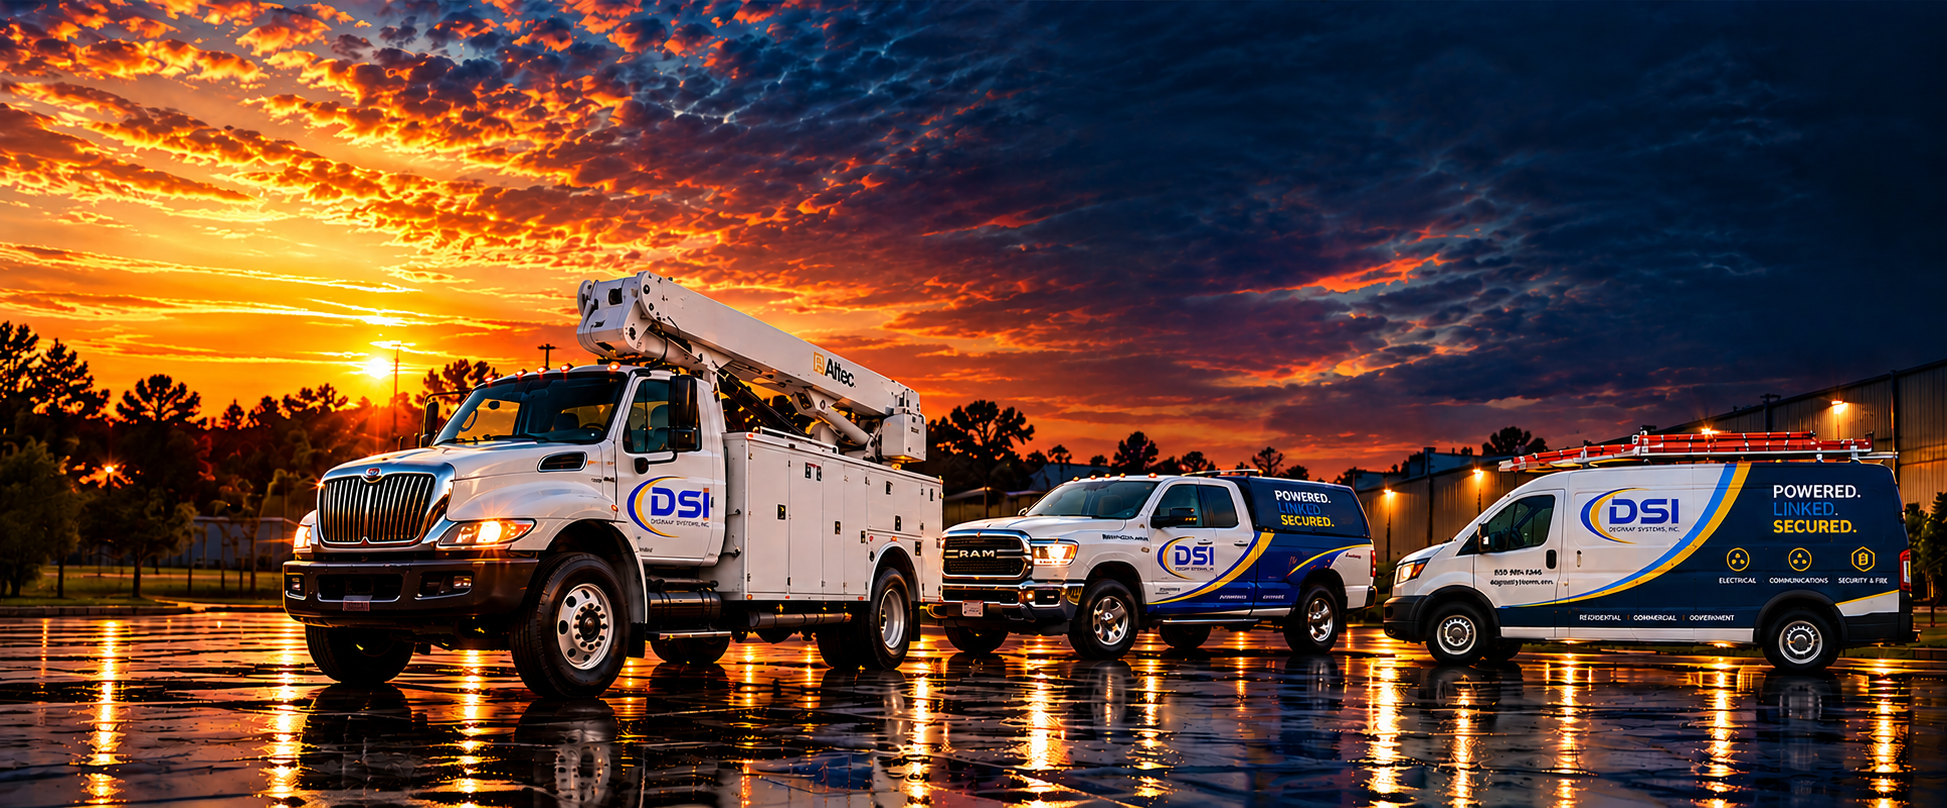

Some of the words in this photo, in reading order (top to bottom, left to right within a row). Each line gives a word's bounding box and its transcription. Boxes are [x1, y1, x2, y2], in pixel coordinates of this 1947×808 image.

[1274, 490, 1331, 504] POWERED.
[1773, 484, 1861, 499] POWERED.
[651, 486, 710, 521] DSI
[1609, 498, 1679, 524] DSI
[1773, 502, 1838, 516] LINKED.
[1281, 514, 1335, 527] SECURED.
[1773, 519, 1857, 534] SECURED.
[959, 549, 996, 558] RAM
[1175, 545, 1214, 566] DSI
